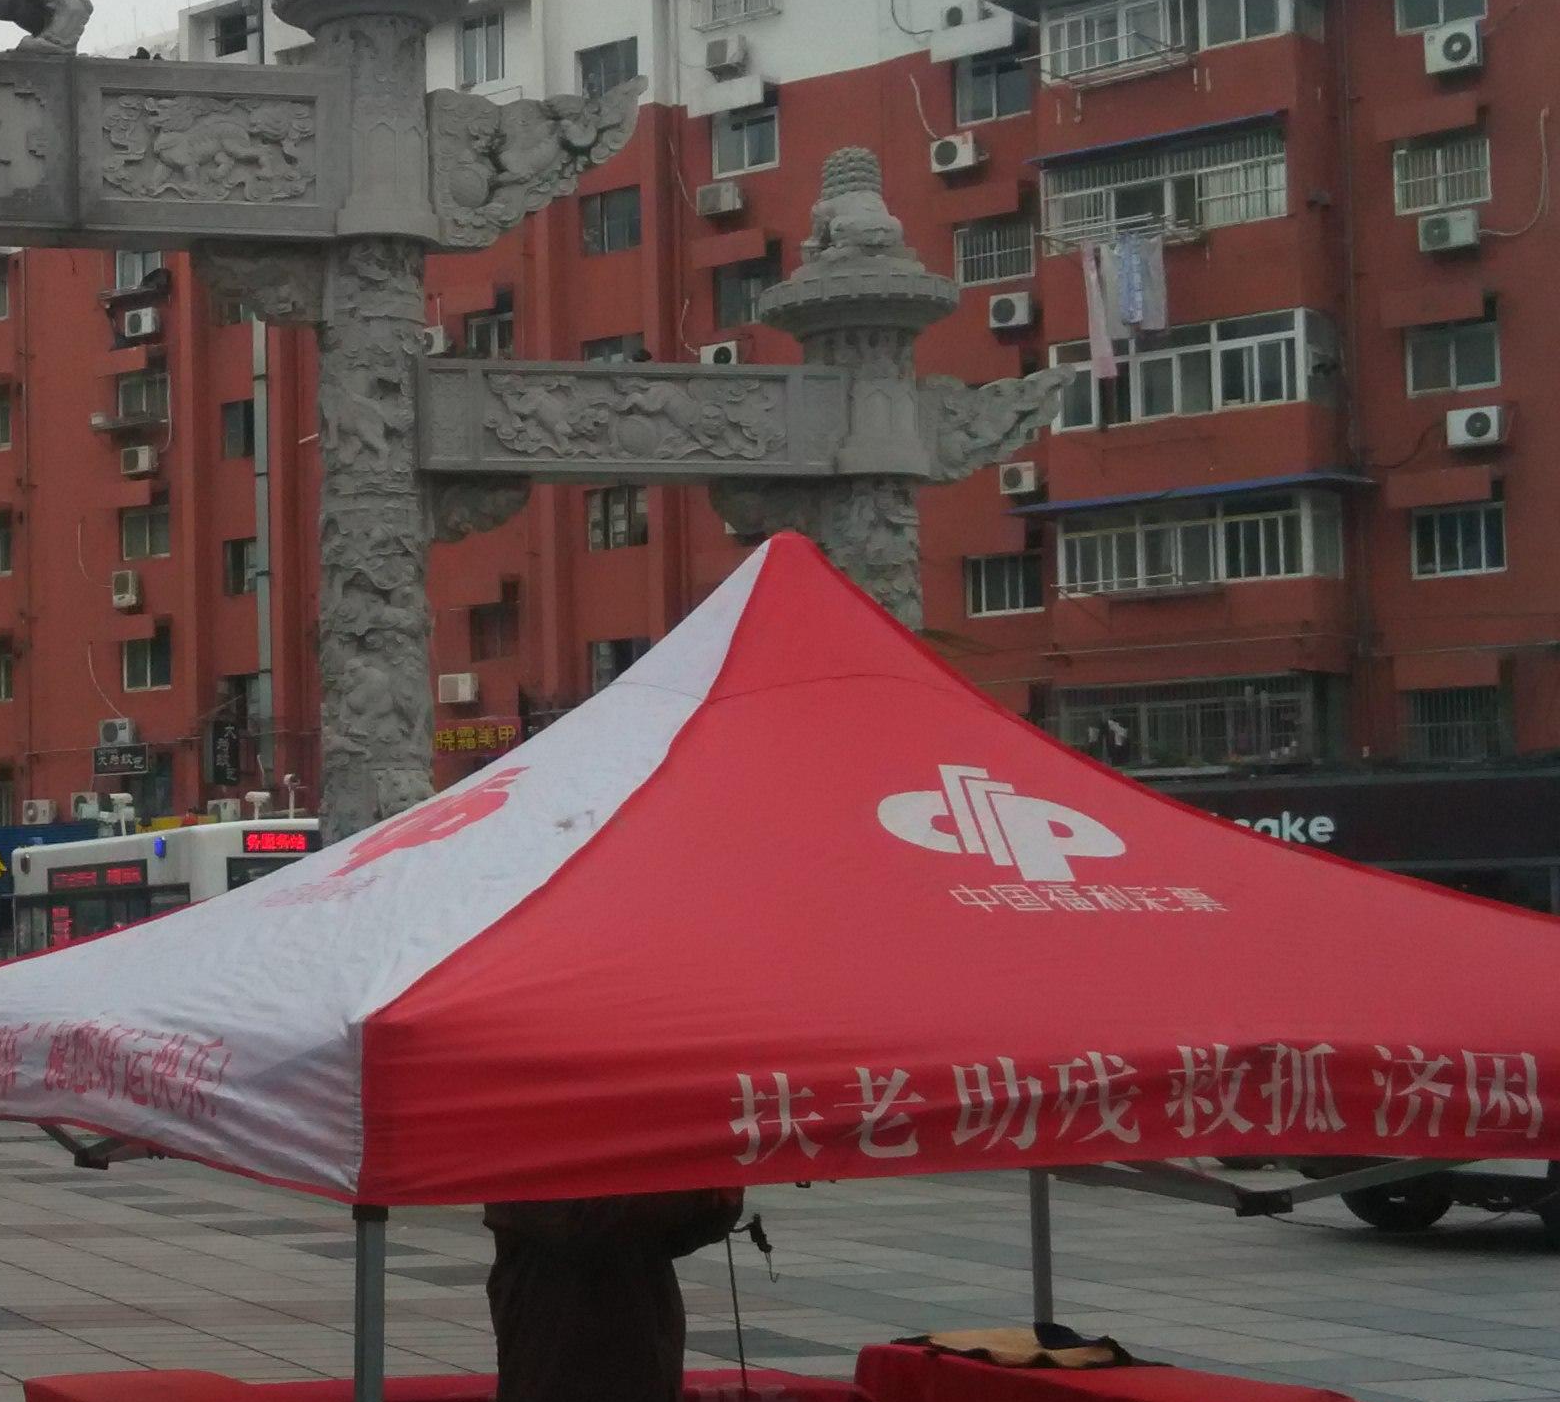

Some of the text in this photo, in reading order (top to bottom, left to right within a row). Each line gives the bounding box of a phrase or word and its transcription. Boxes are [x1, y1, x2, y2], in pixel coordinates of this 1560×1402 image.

[1233, 810, 1336, 844] ake
[947, 883, 1232, 914] 中国福利彩票
